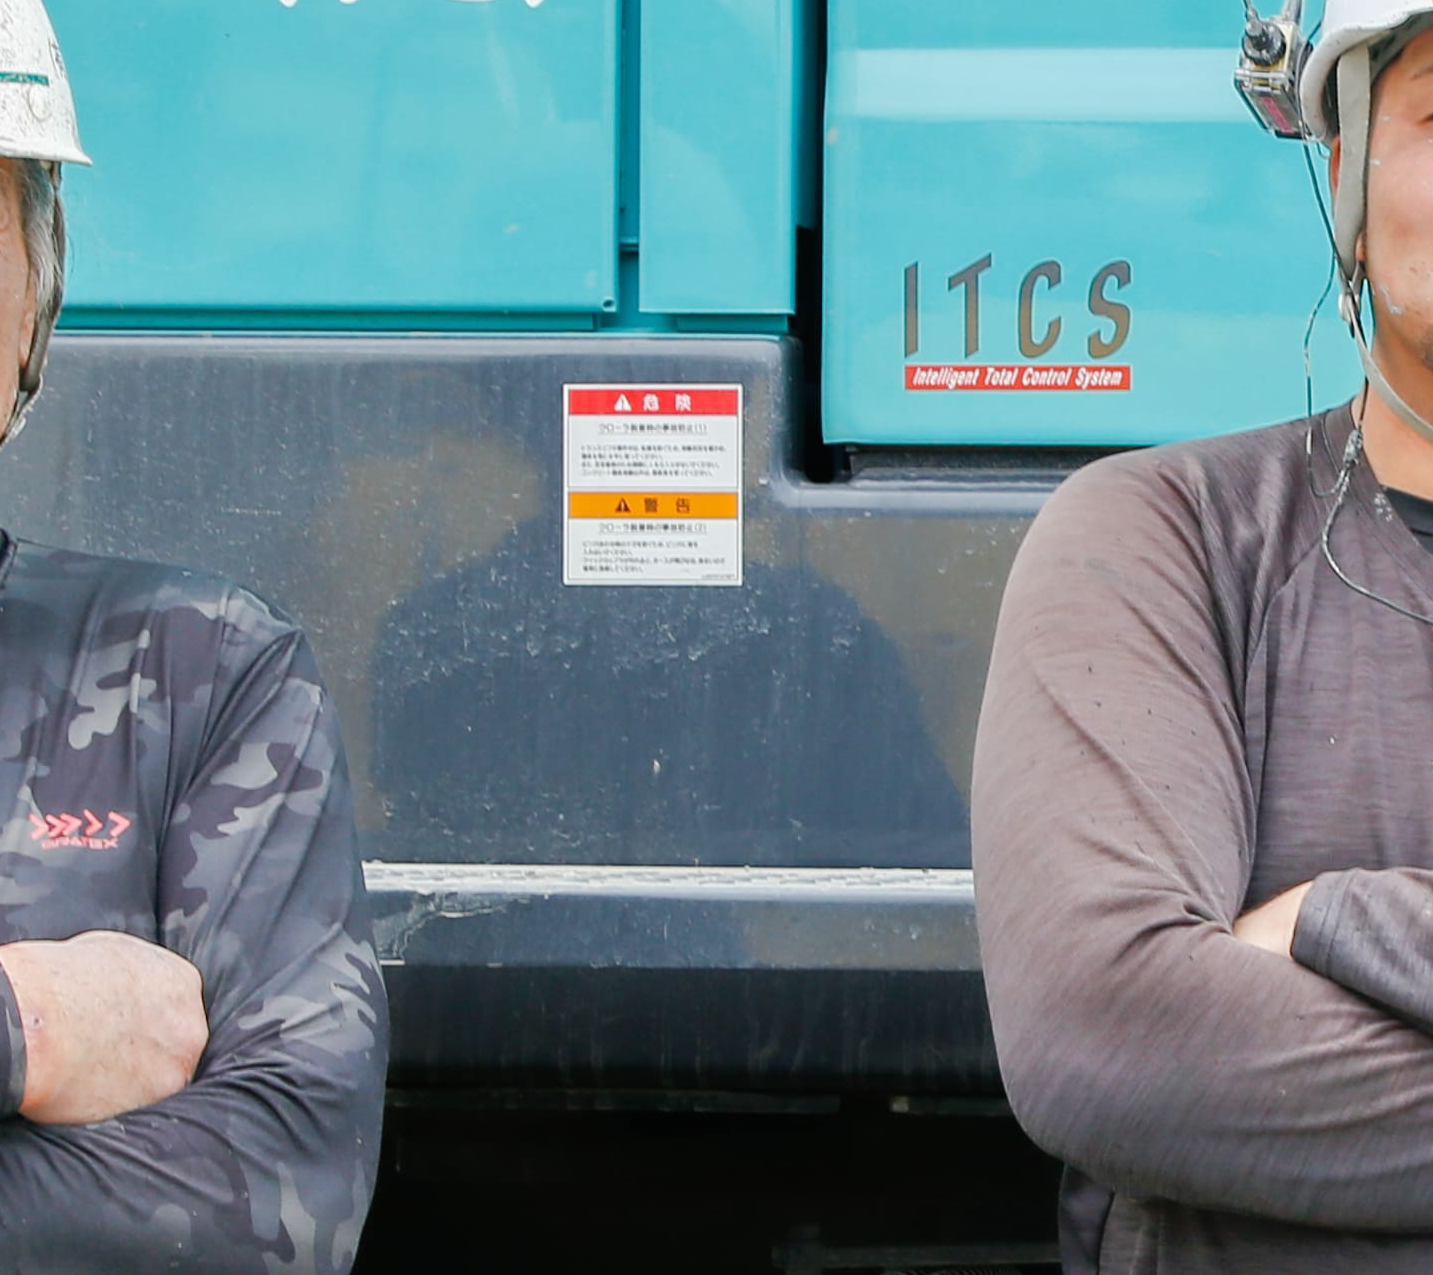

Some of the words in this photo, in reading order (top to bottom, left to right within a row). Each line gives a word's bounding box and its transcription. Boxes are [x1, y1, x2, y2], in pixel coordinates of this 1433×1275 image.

[903, 251, 1132, 360] ITCS
[912, 367, 980, 390] Intelligent
[984, 367, 1018, 386] Total
[1022, 367, 1072, 386] Control
[1075, 367, 1123, 390] System
